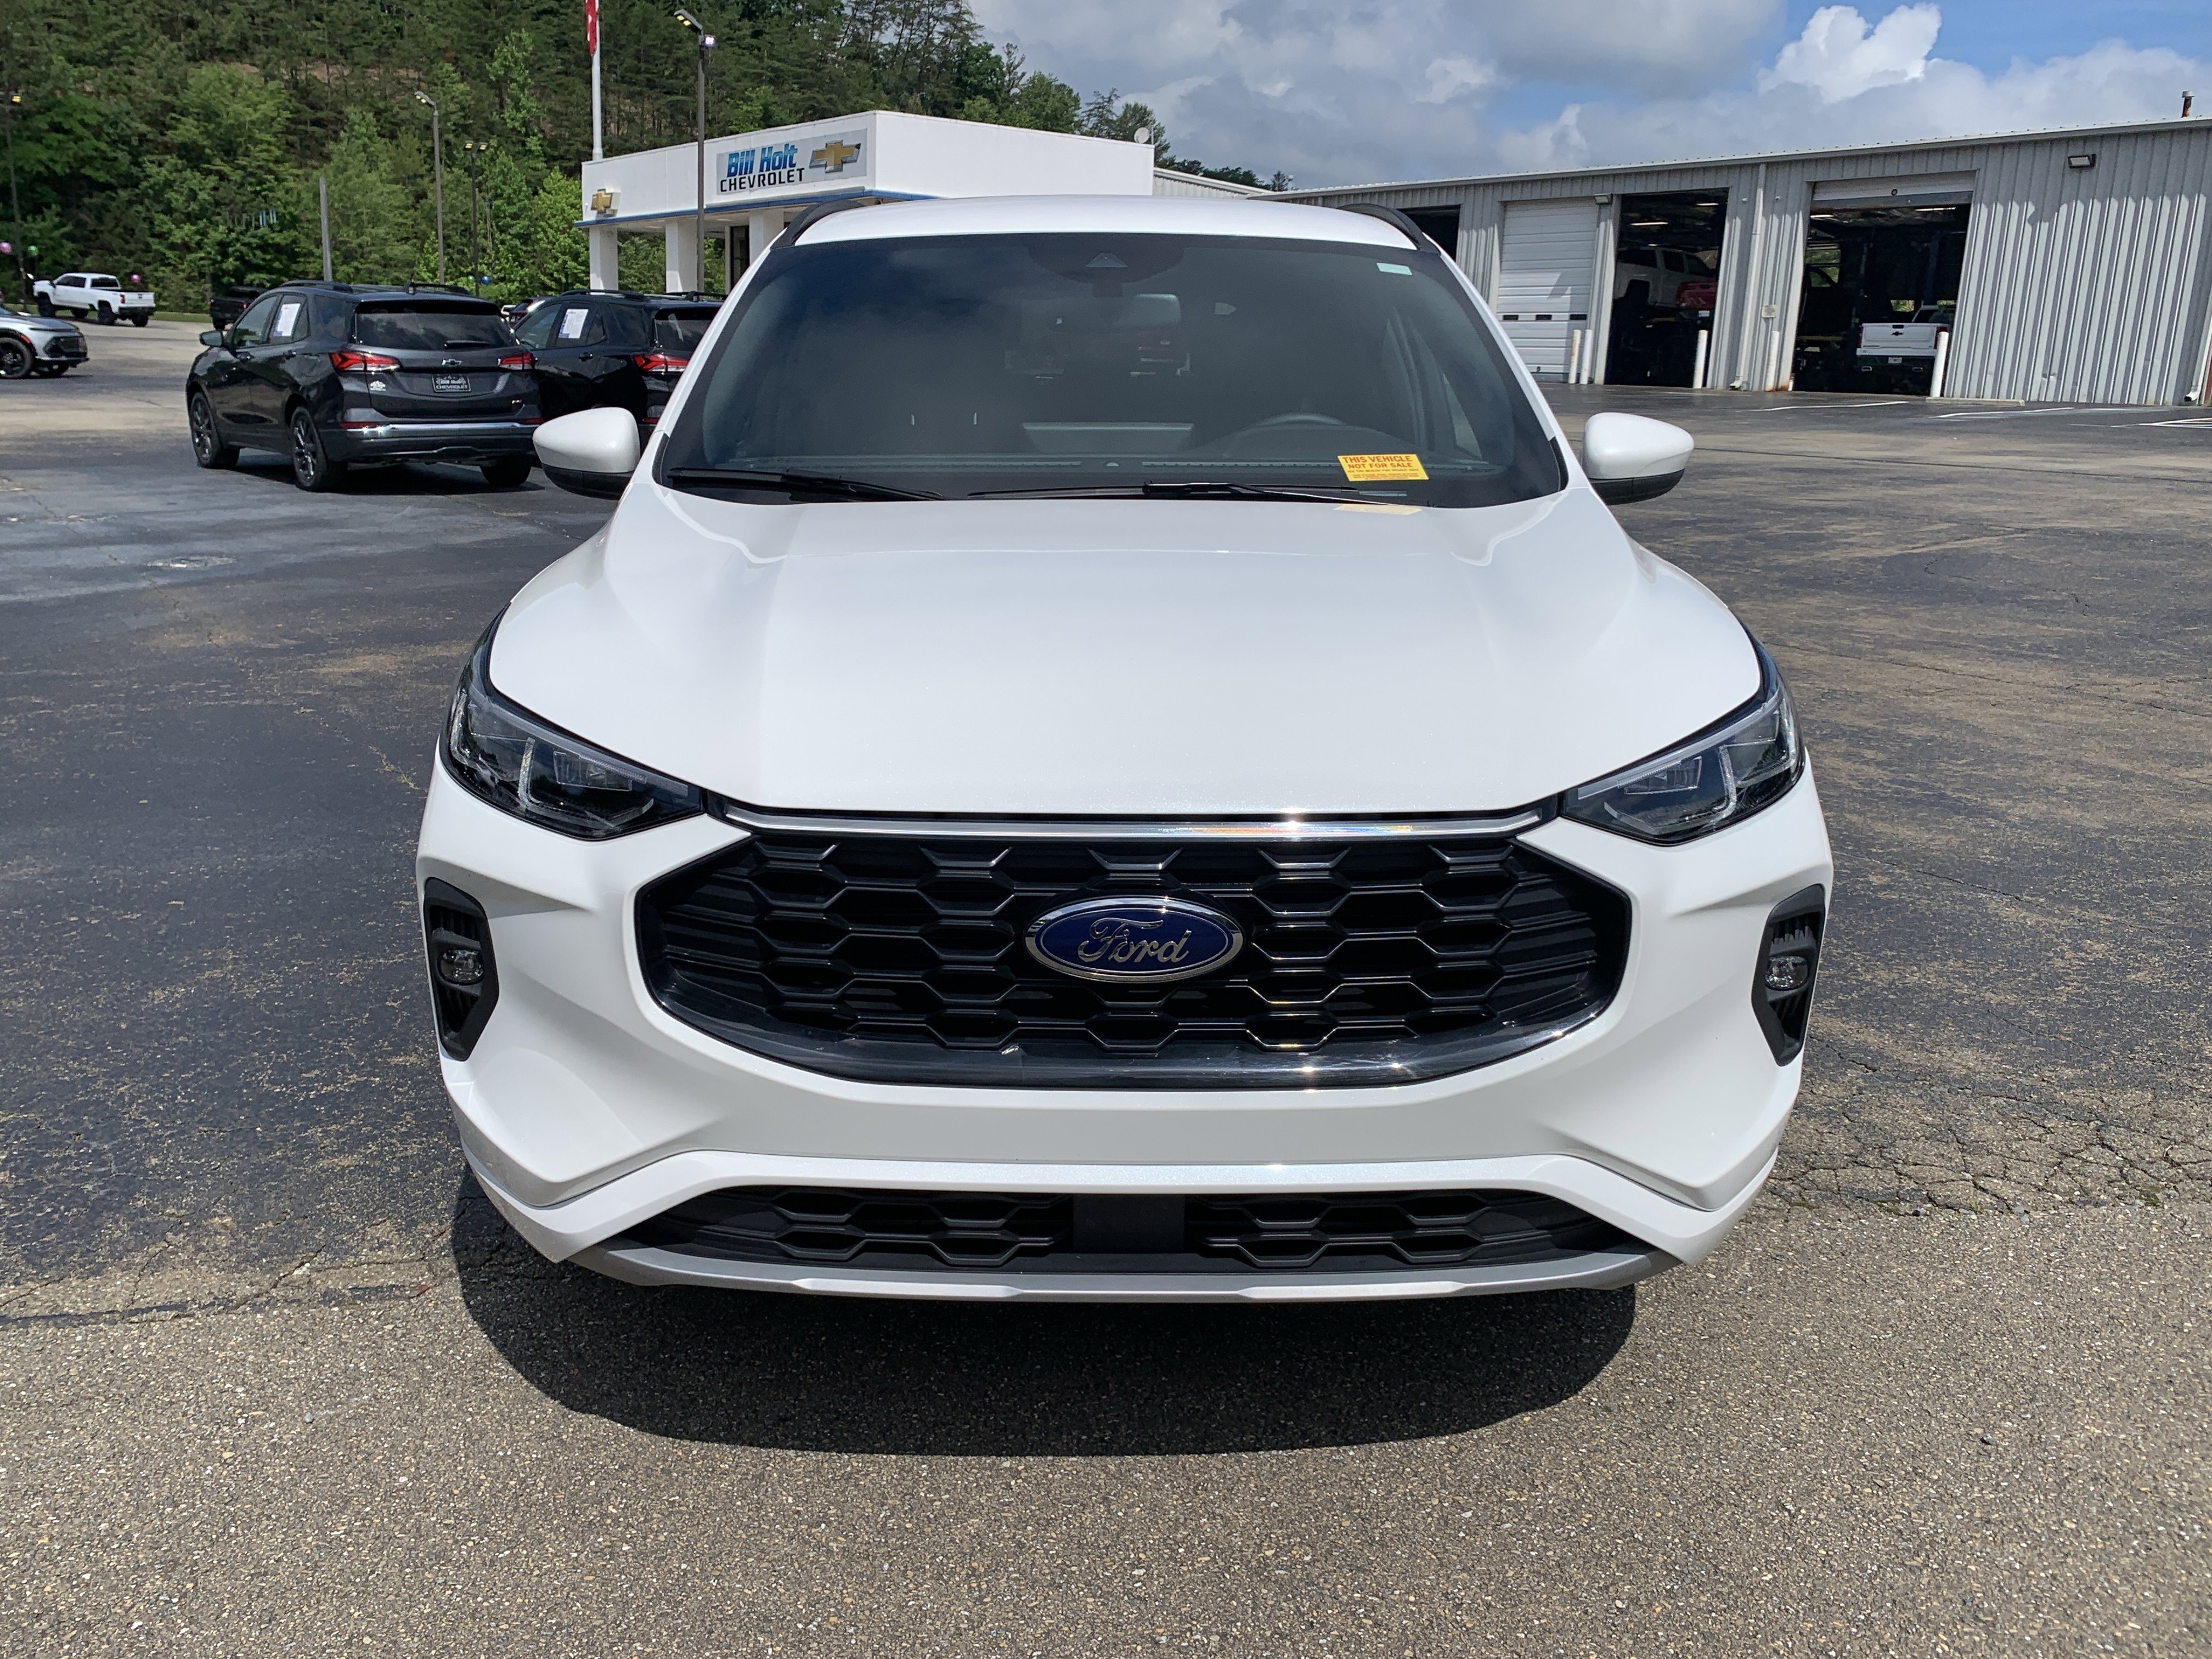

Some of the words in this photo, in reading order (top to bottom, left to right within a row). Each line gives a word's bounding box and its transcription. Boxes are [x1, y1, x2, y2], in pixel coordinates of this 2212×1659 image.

[726, 149, 755, 178] Bill
[759, 143, 798, 173] Holt
[720, 168, 805, 192] CHEVROLET
[1078, 917, 1192, 963] Ford
